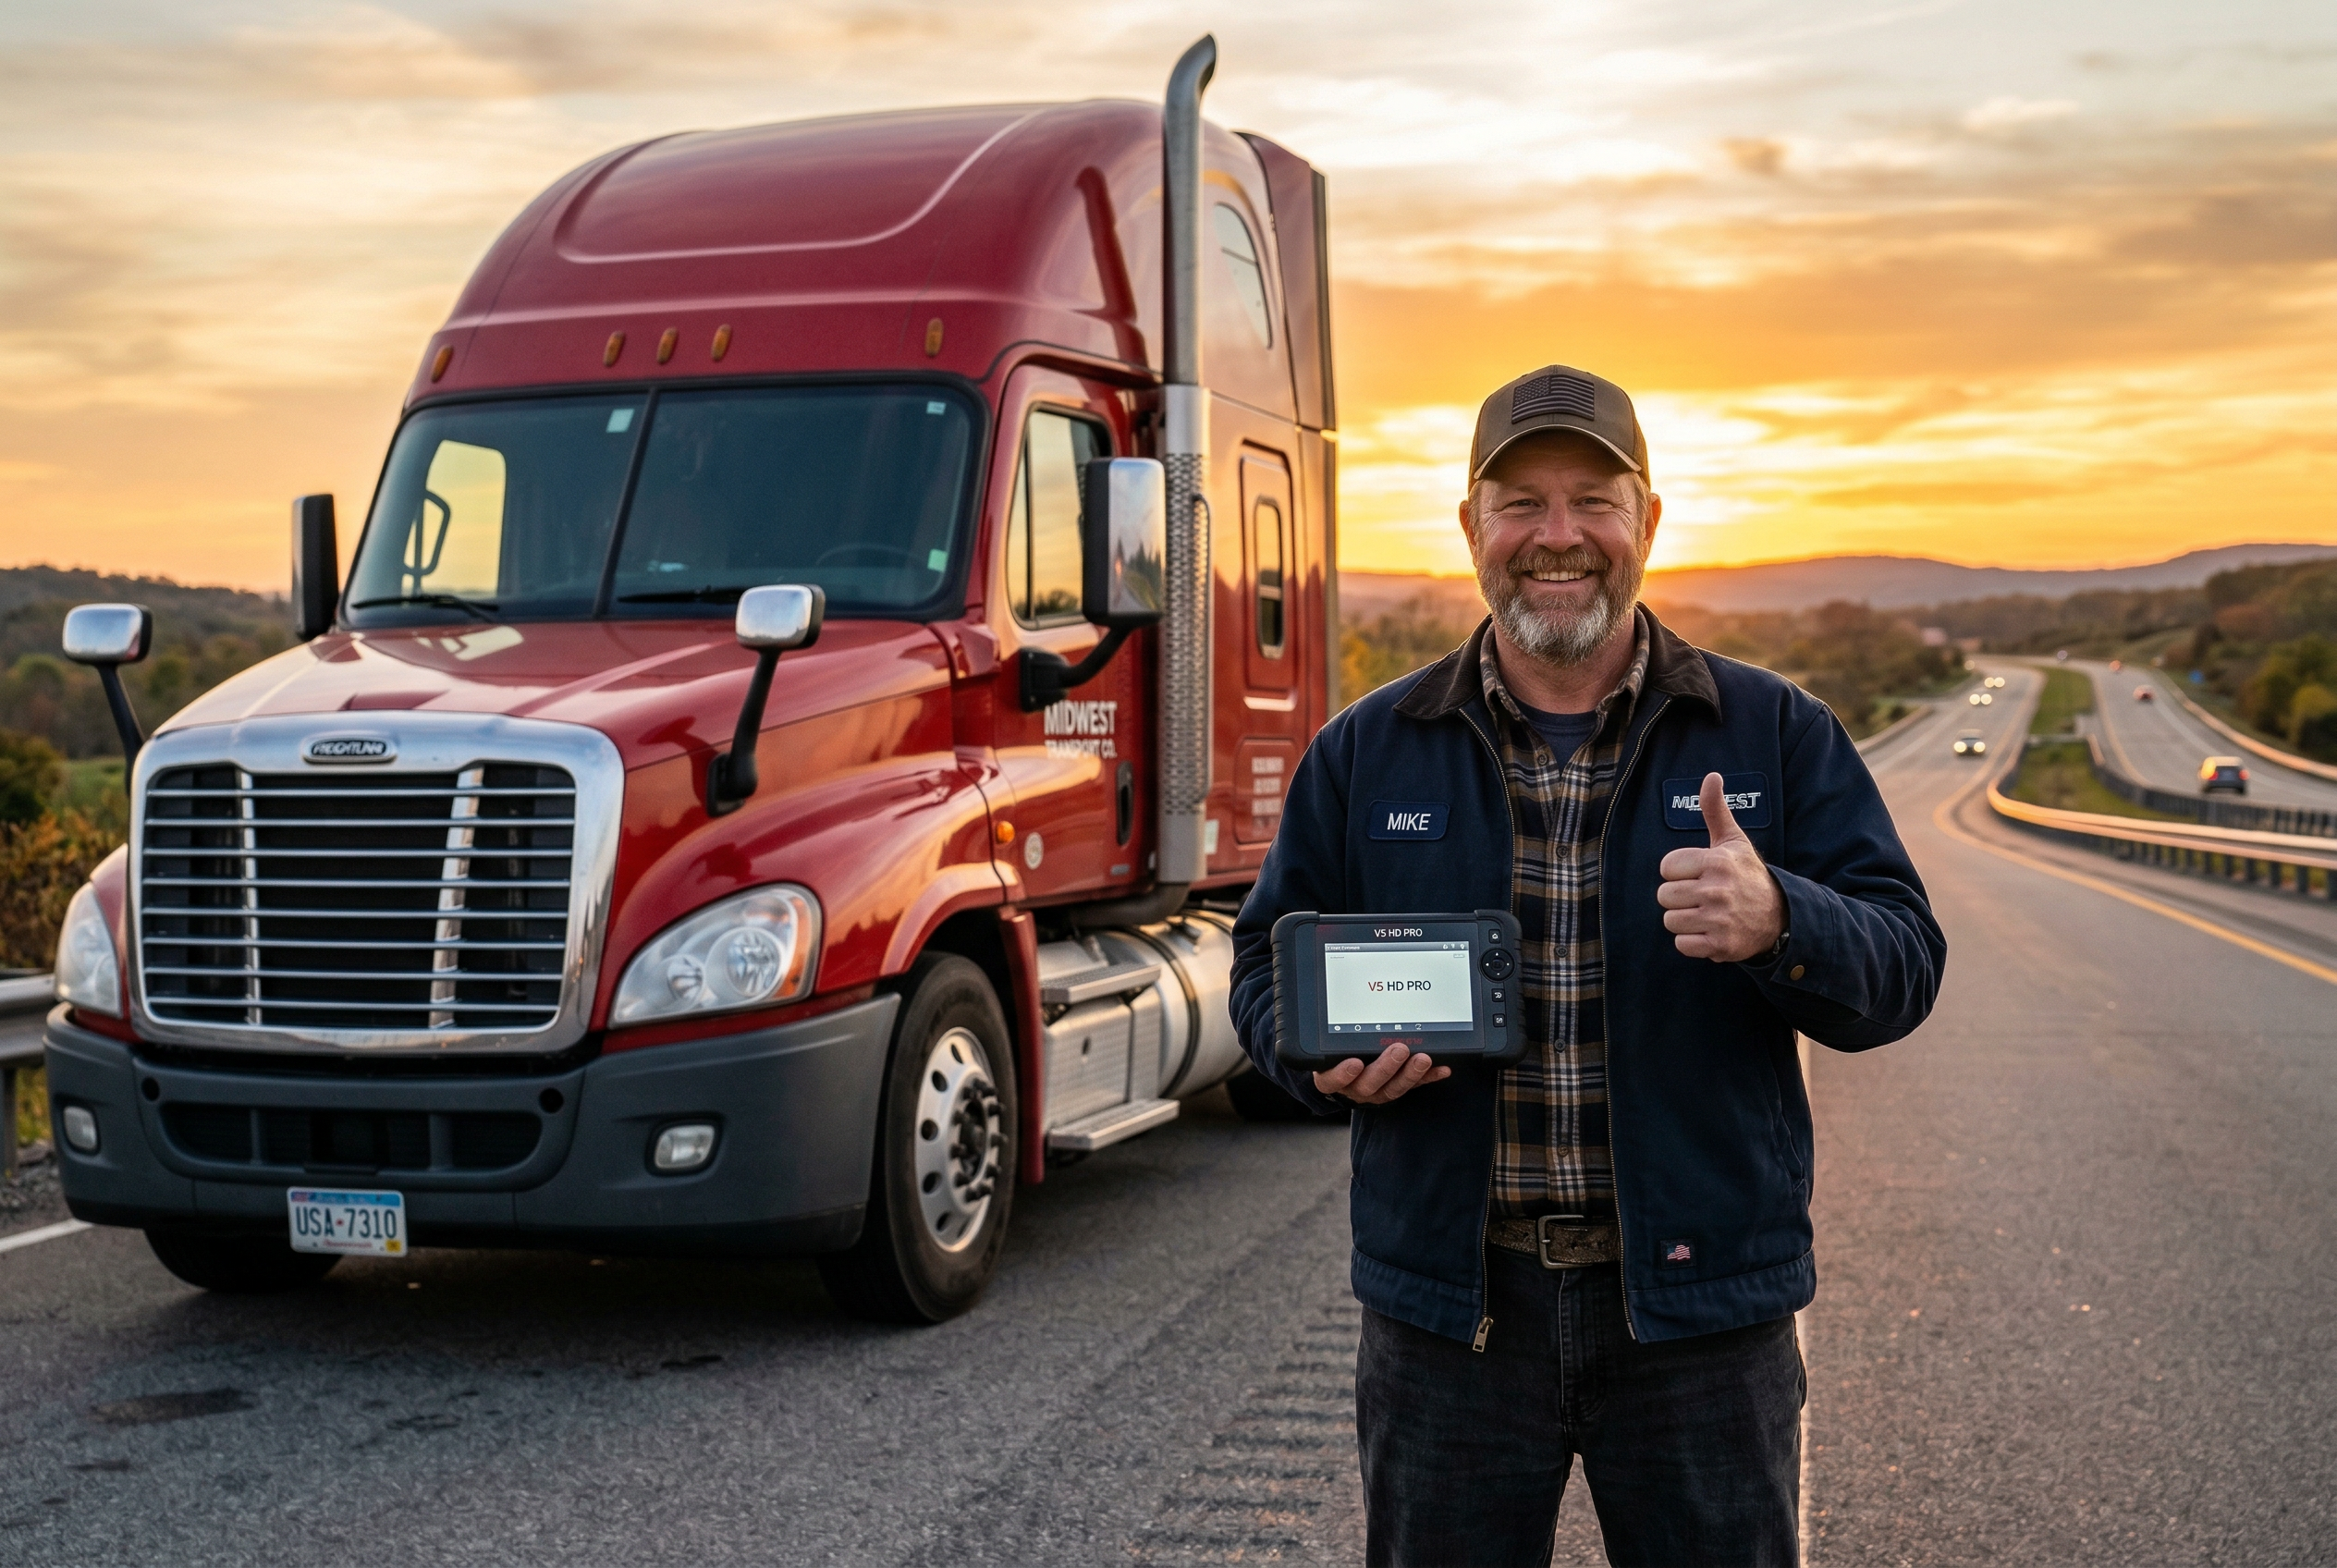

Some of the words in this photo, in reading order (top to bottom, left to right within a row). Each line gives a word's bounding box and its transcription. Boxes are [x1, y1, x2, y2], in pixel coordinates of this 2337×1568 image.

[1044, 700, 1117, 735] MIDWEST
[1387, 813, 1431, 831] MIKE
[1374, 928, 1387, 937] V5
[1388, 928, 1401, 937] HD
[1403, 928, 1423, 937] PRO
[1368, 981, 1384, 992] V5
[1387, 981, 1404, 991] HD
[1407, 980, 1432, 991] PRO
